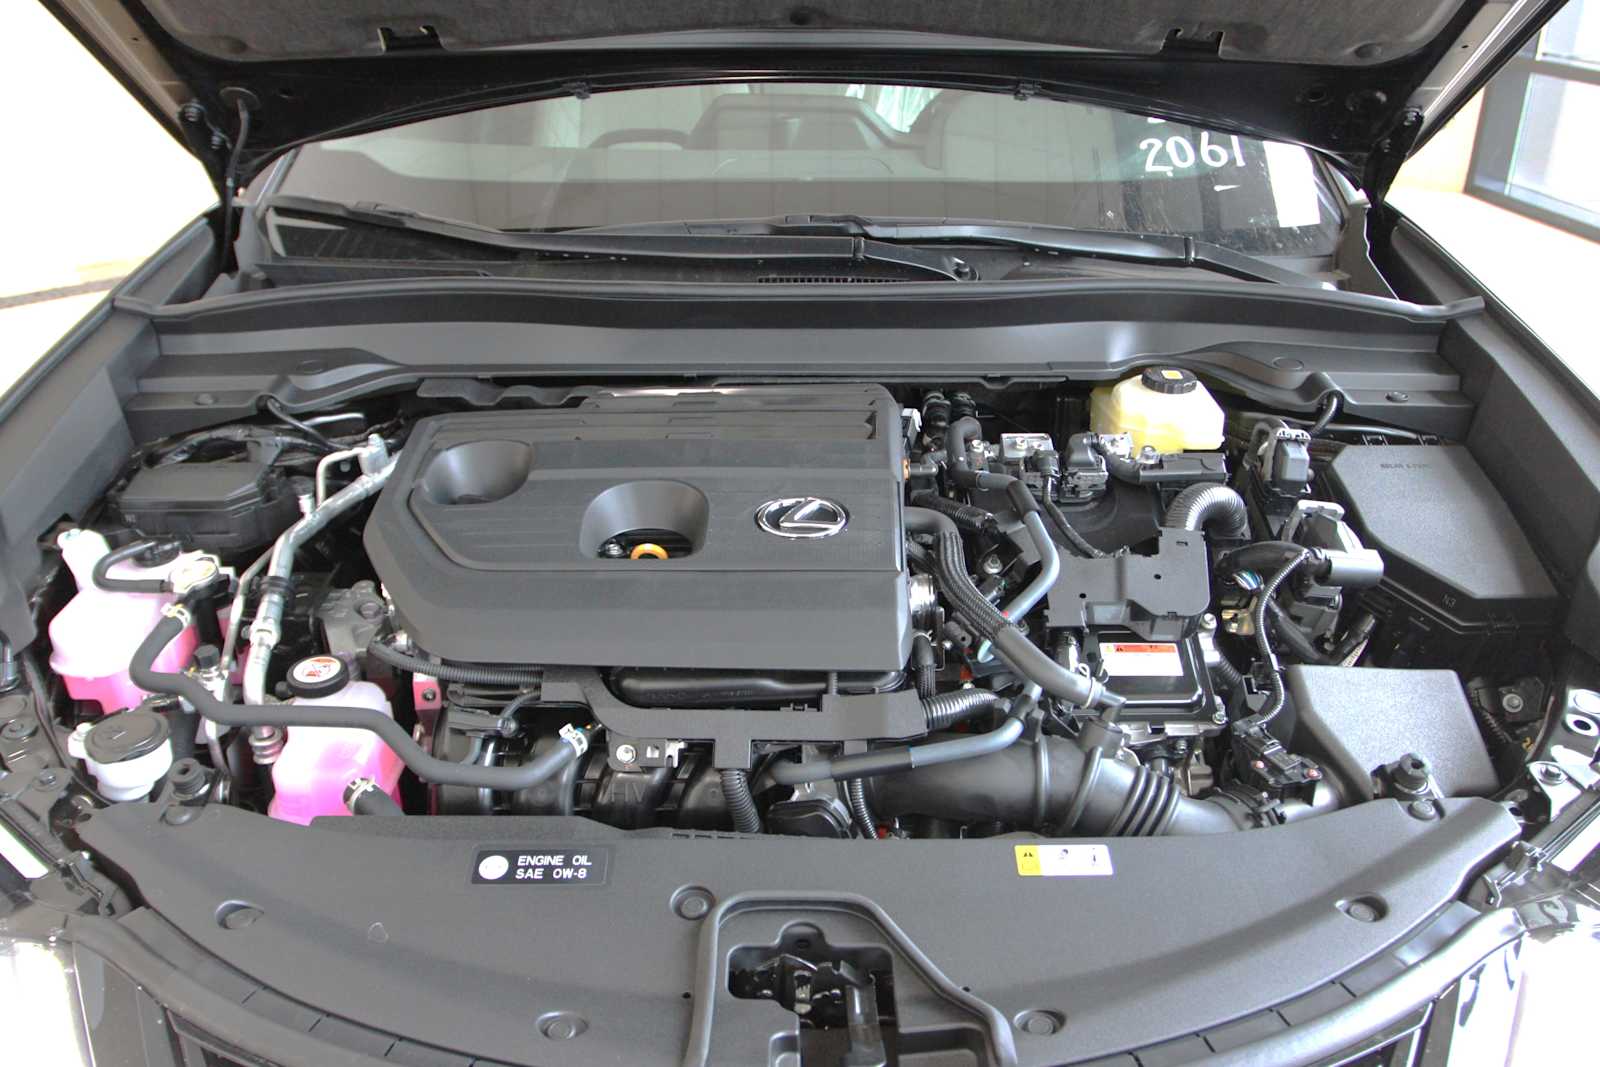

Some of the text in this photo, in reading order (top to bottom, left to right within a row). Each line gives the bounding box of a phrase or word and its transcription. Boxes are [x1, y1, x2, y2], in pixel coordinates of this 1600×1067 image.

[1139, 131, 1246, 172] 2061
[517, 855, 592, 866] ENGINE OIL
[515, 868, 544, 879] SAE
